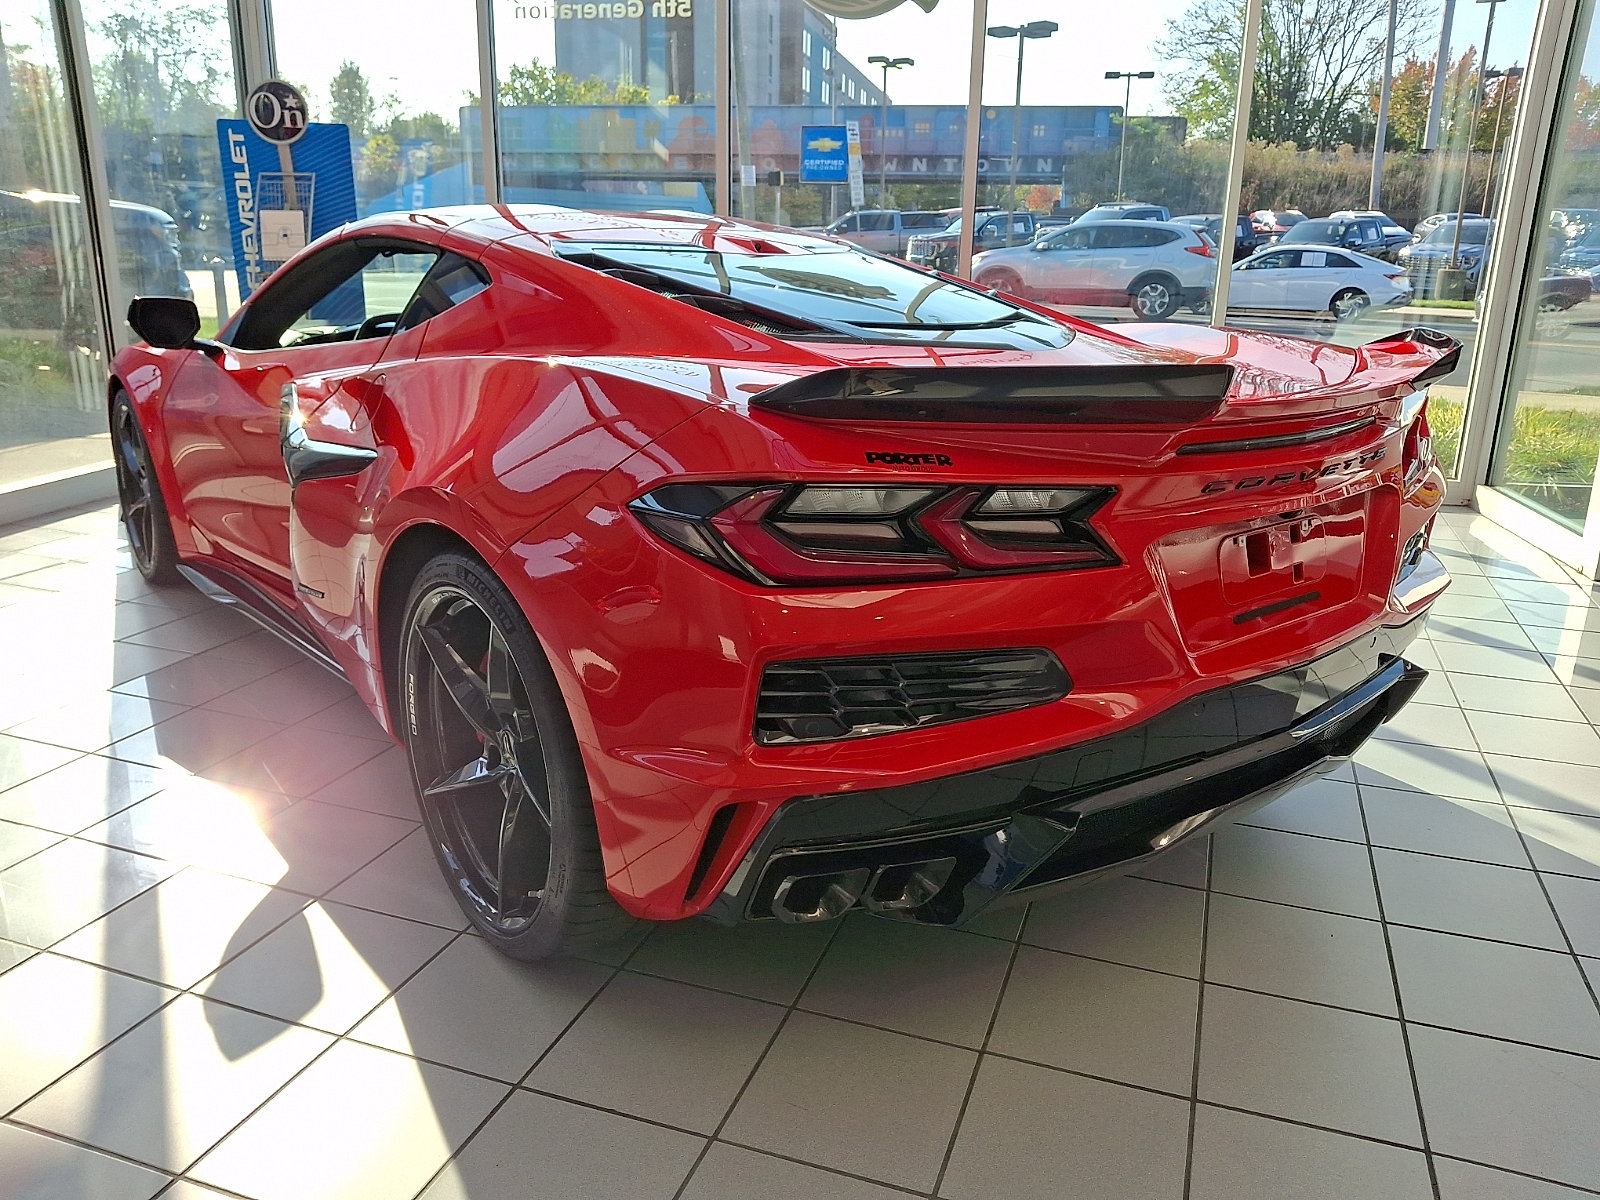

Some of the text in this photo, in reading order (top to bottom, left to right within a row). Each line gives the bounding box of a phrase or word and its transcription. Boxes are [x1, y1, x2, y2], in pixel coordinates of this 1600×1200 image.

[250, 91, 305, 129] On
[228, 128, 261, 291] CHEVROLET
[865, 452, 953, 466] PORTER
[1201, 447, 1387, 494] CORVETTE
[466, 572, 514, 631] MICHELIN
[408, 673, 418, 736] FORGED
